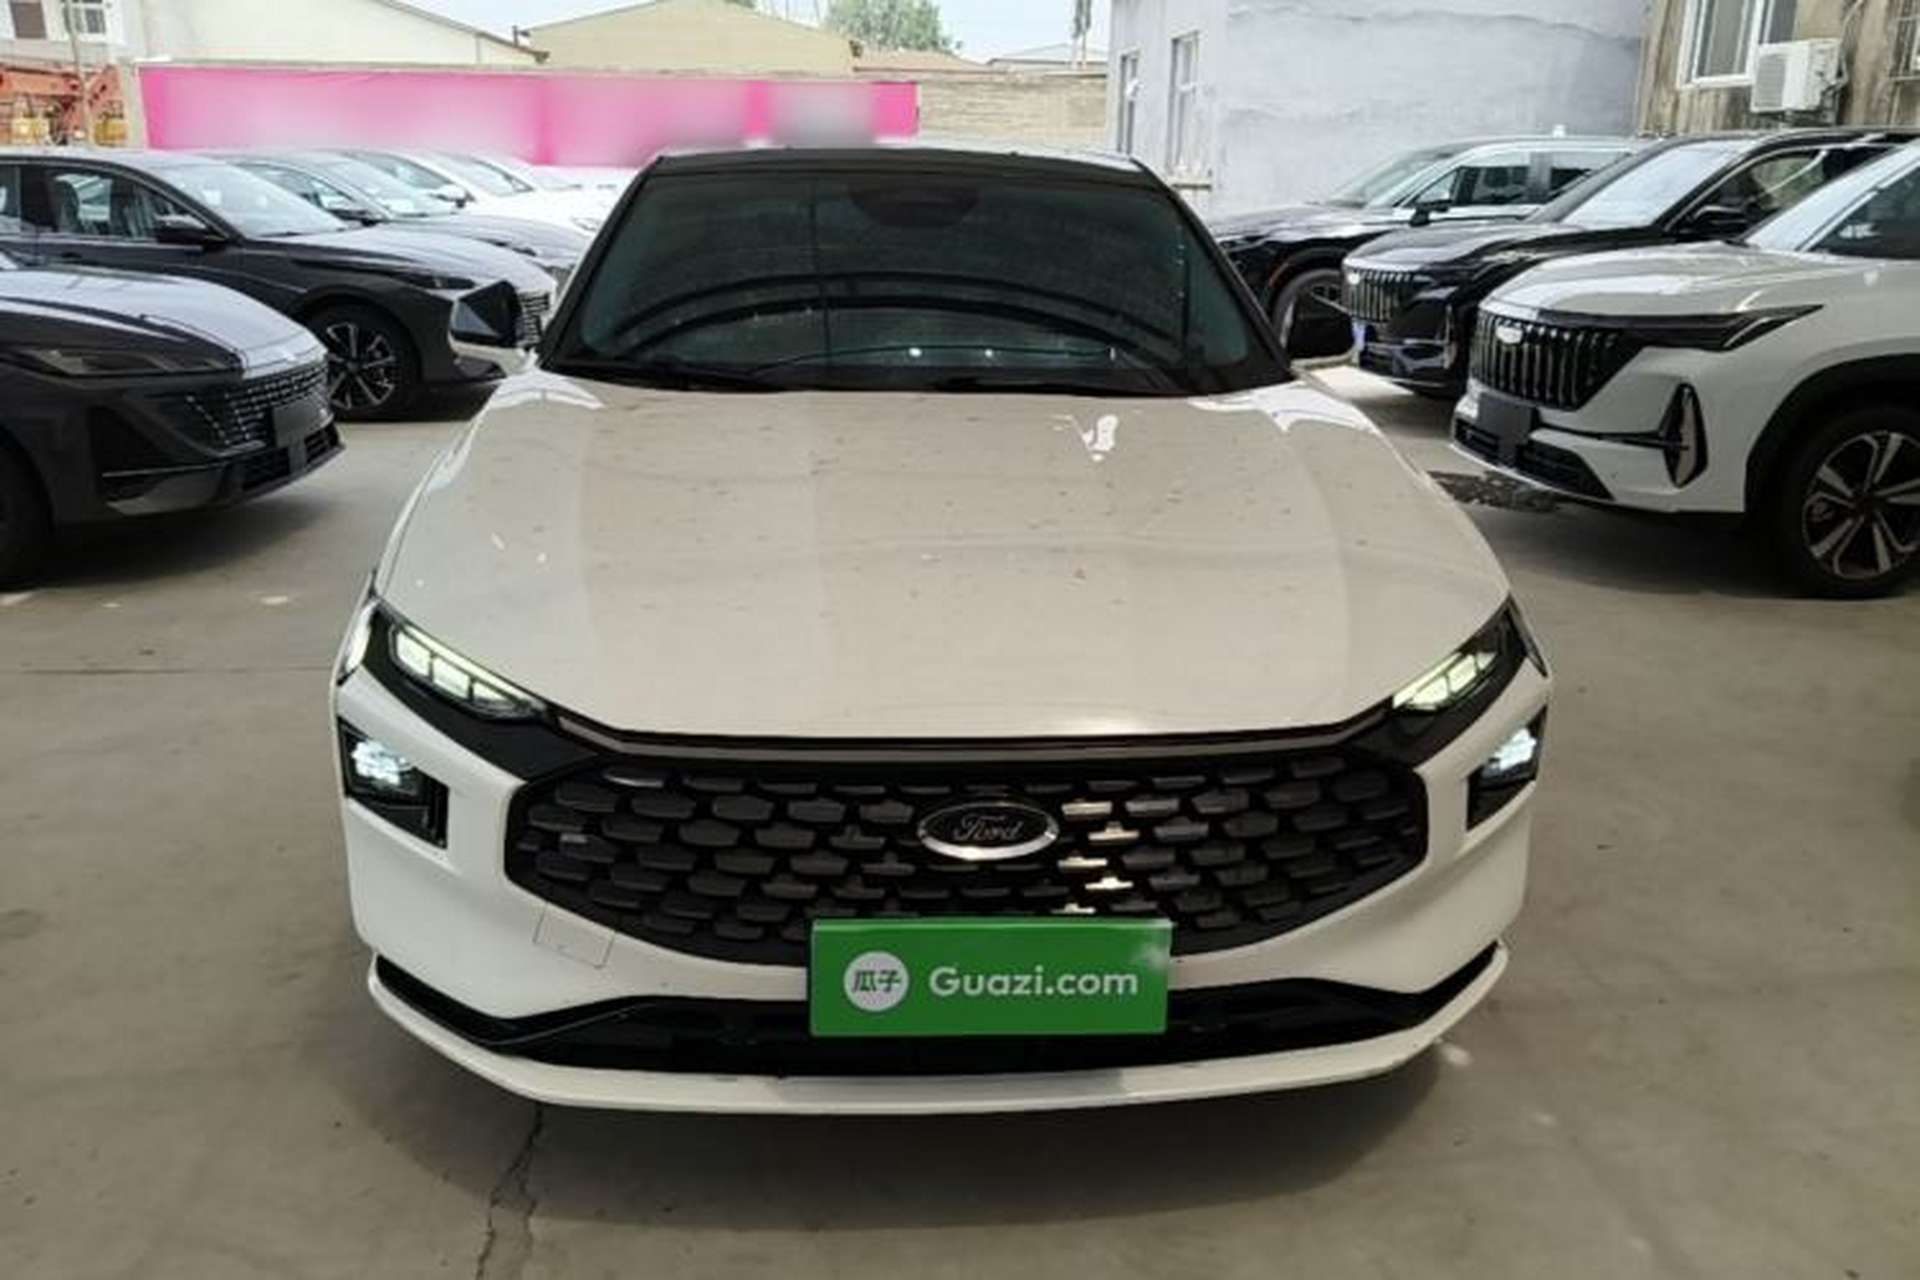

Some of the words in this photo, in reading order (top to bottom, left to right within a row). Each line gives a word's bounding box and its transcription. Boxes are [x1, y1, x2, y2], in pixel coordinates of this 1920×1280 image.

[953, 813, 1024, 841] Ford
[853, 968, 901, 994] 瓜子
[929, 965, 1138, 997] Guazi.com
